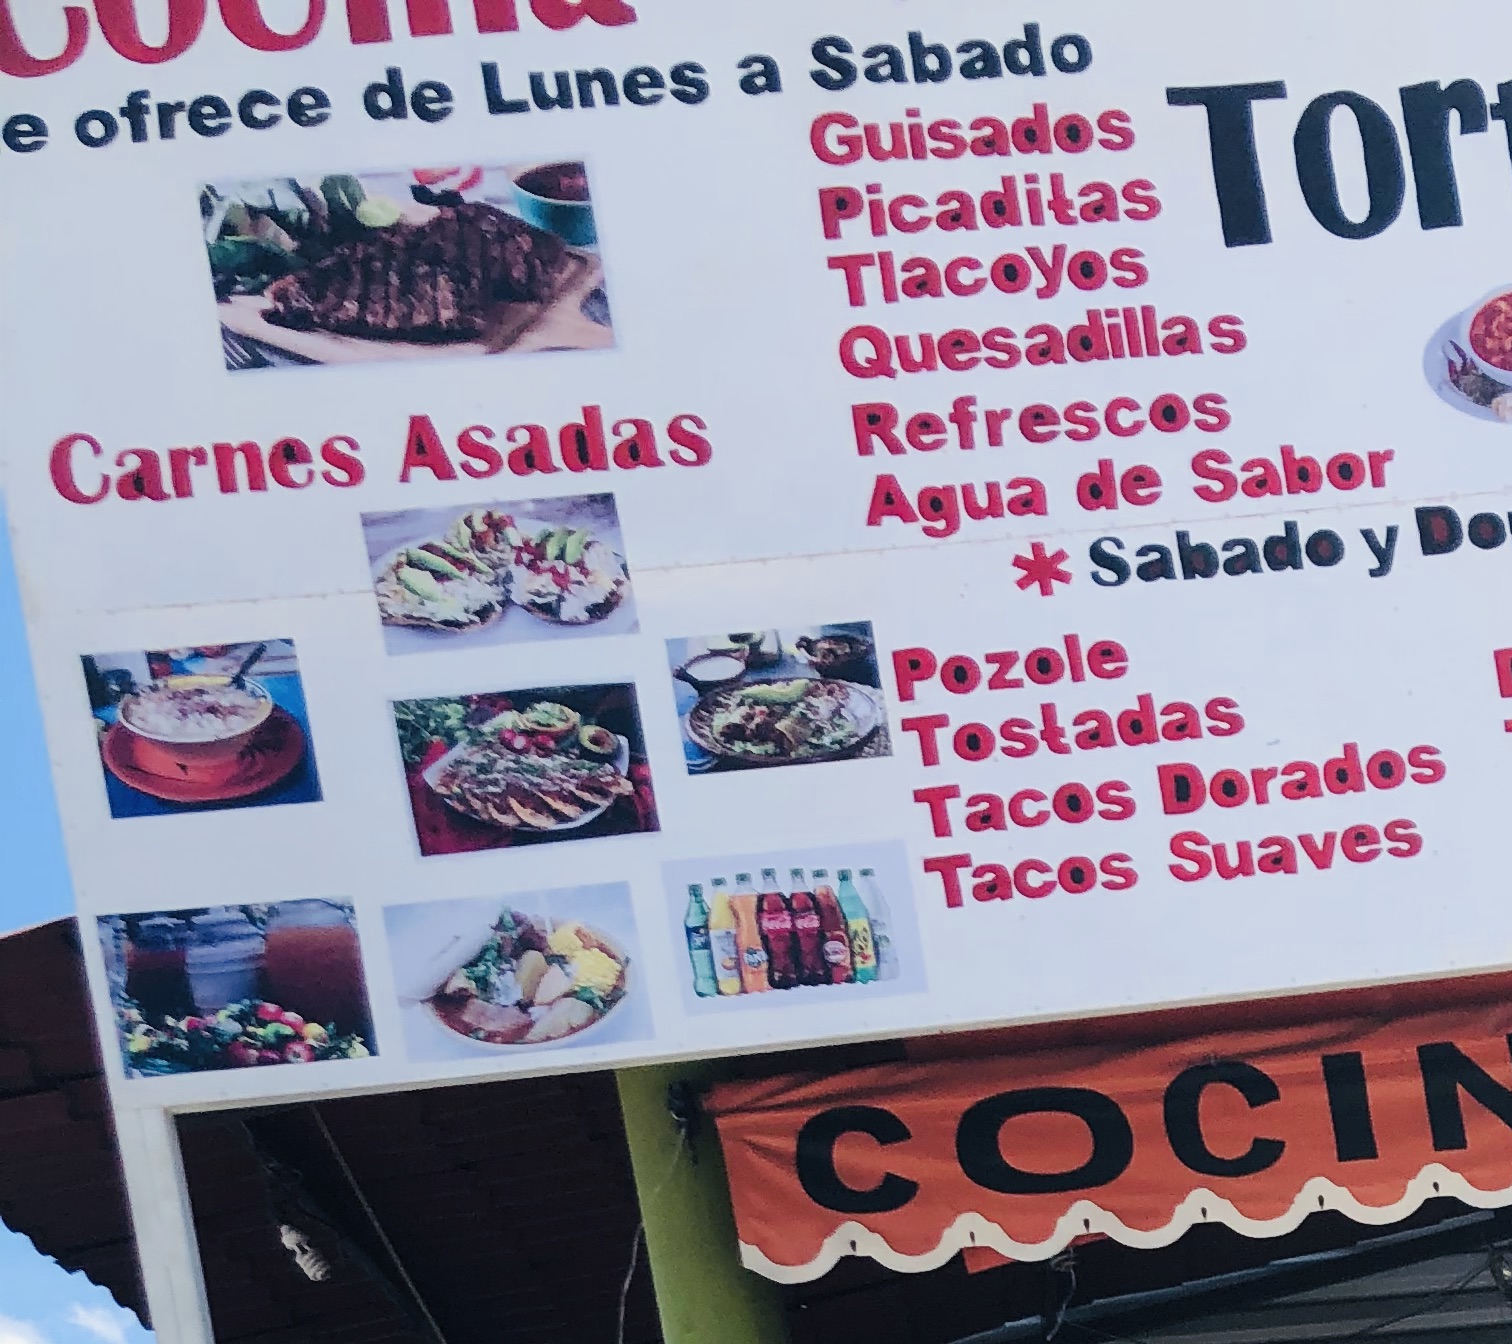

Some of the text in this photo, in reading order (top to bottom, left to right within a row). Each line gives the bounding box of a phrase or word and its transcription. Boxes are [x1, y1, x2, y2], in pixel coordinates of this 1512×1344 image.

[74, 85, 331, 148] ofrece
[363, 67, 453, 122] de
[481, 58, 710, 116] Lunes
[738, 51, 781, 96] a
[808, 22, 1093, 93] Sabado
[809, 101, 1136, 168] Guisados
[817, 172, 1163, 241] Picaditas
[827, 241, 1150, 308] Tlacoyos
[838, 305, 1247, 382] Quesadillas
[48, 404, 714, 505] Carnes Asadas
[851, 386, 1232, 457] Refrescos
[866, 440, 1395, 539] Agua de Sabor
[1089, 519, 1347, 589] Sabado
[1360, 525, 1399, 580] y
[891, 632, 1131, 701] Pozole
[901, 693, 1246, 767] Tostadas
[914, 739, 1447, 841] Tacos Dorados
[924, 817, 1423, 909] Tacos Suaves
